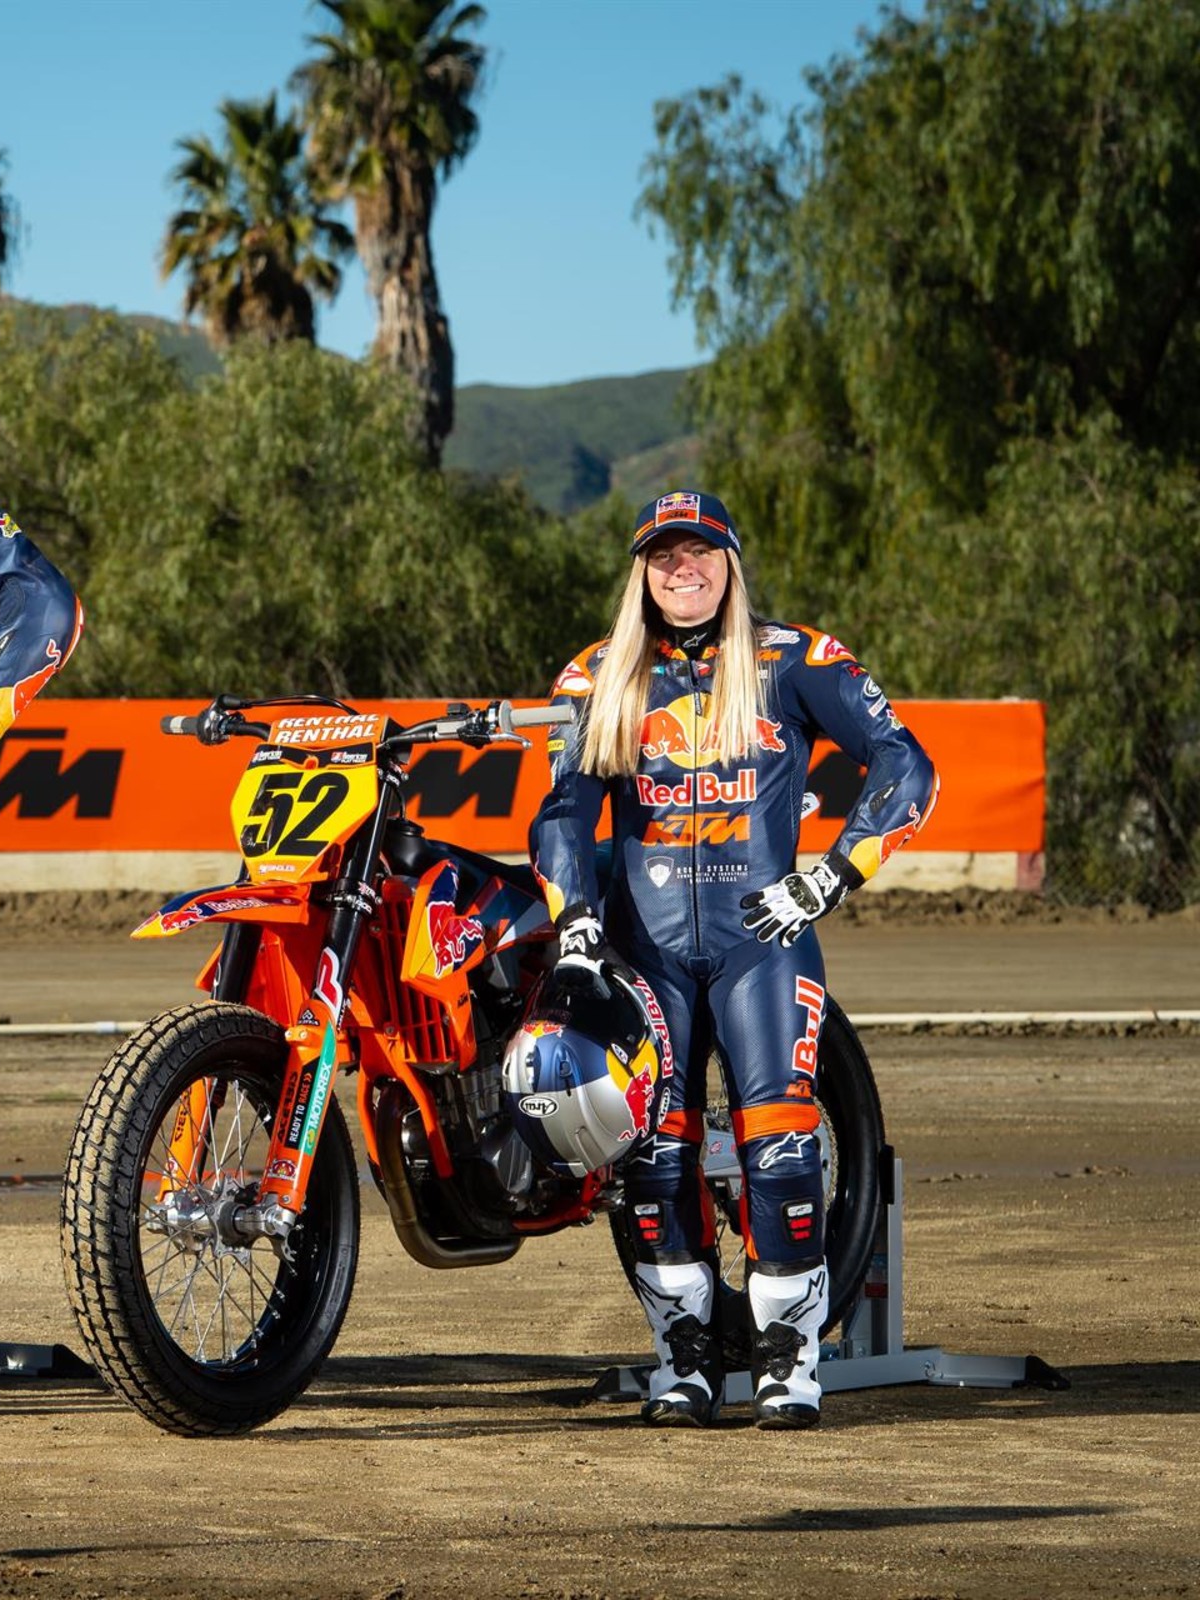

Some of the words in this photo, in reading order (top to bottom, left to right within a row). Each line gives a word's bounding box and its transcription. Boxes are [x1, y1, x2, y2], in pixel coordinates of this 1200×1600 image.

[275, 725, 375, 744] RENTHAL
[636, 774, 692, 807] Red
[697, 769, 757, 802] Bull
[241, 772, 349, 858] 52
[641, 811, 750, 847] KTM
[707, 864, 748, 873] SYSTEMS
[634, 975, 664, 1027] Bull
[791, 975, 826, 1079] Bull
[655, 1023, 673, 1079] Red
[309, 1061, 332, 1129] MOTOREX
[524, 1098, 557, 1114] Arai
[289, 1115, 303, 1142] READY
[296, 1104, 305, 1116] TO
